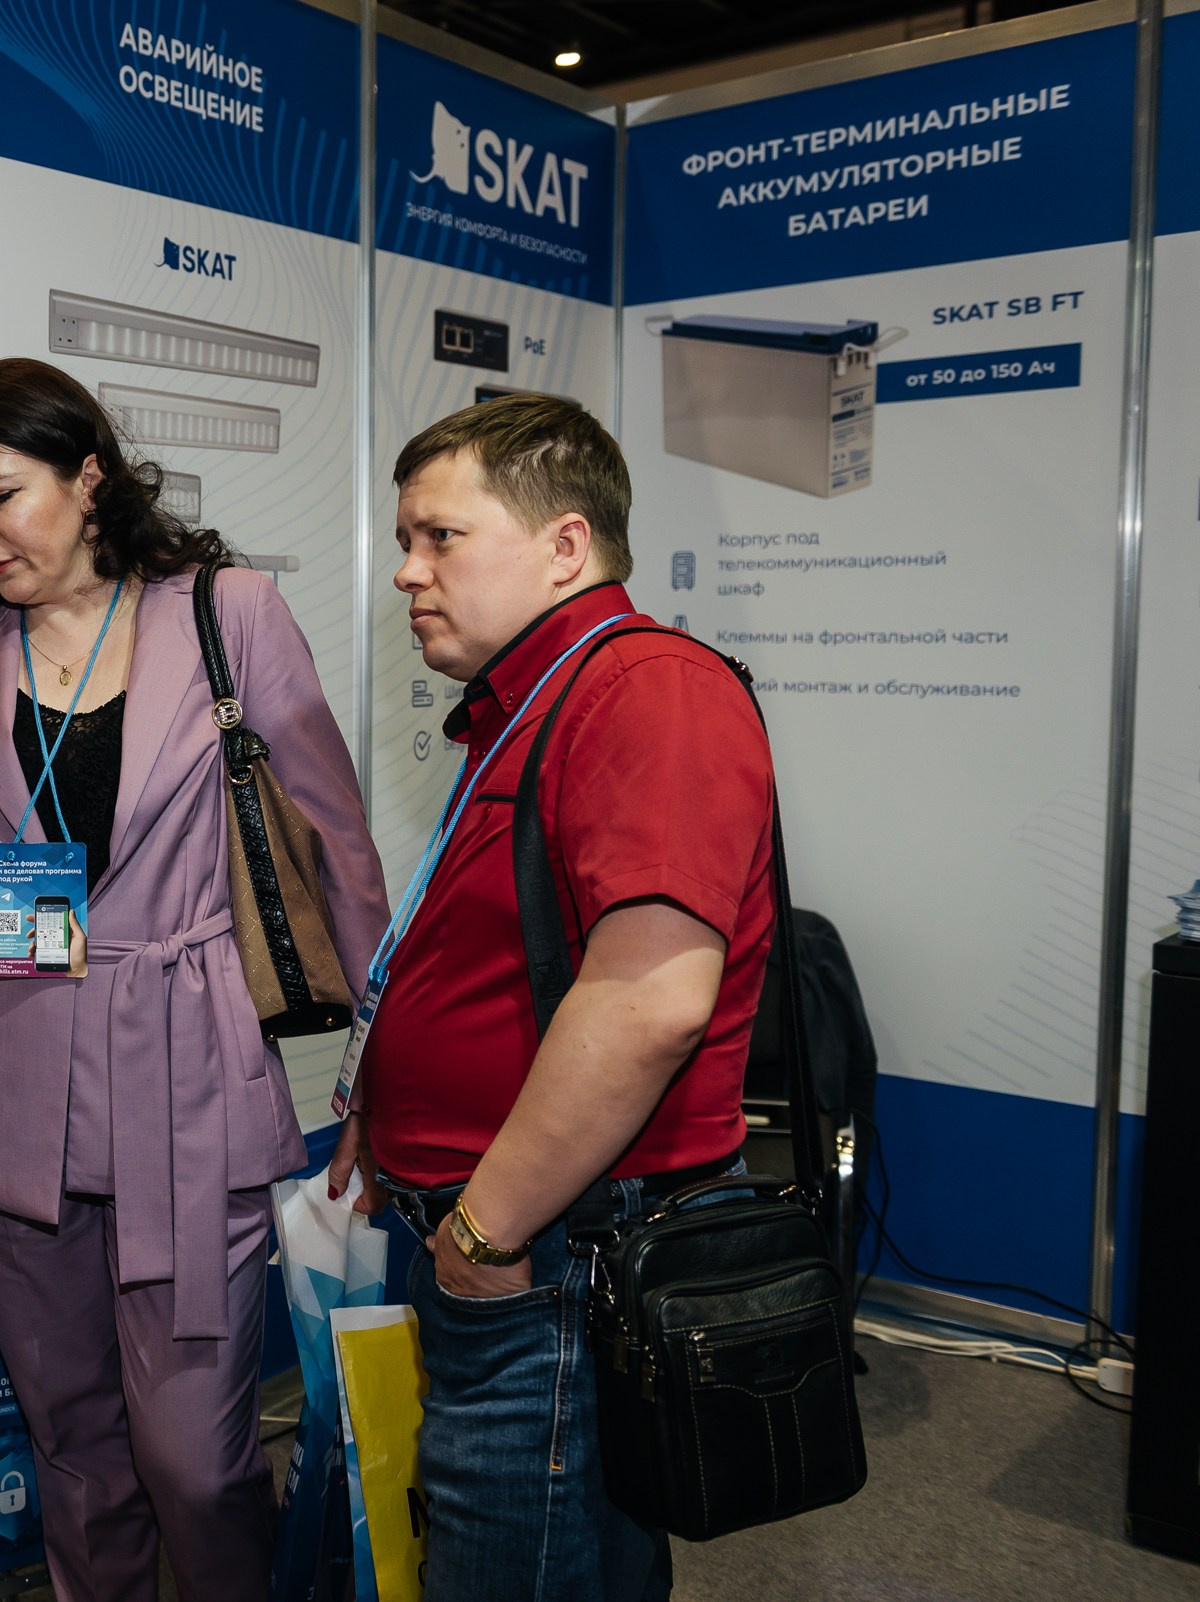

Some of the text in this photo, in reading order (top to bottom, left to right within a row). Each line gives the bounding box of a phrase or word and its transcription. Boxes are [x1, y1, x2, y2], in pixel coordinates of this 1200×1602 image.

[119, 23, 263, 94] АВАРИЙНОЕ
[118, 63, 264, 134] ОСВЕЩЕНИЕ
[681, 83, 1071, 178] ФРОНТ-ТЕРМИНАЛЬНЫЕ
[473, 128, 589, 229] SKAT
[716, 136, 1023, 210] АККУМУЛЯТОРНЫЕ
[787, 193, 930, 238] БАТАРЕИ
[405, 201, 588, 265] ЭНЕРГИЯ КОМФОРТА И БЕЗОПАСНОСТИ
[181, 245, 237, 282] SKAT
[932, 291, 1085, 326] SKAT SB FT
[524, 335, 546, 356] PoE
[905, 357, 1056, 388] от 50 до 150 Ач
[717, 530, 820, 550] Корпус под
[717, 551, 948, 573] телекоммуникационный
[717, 580, 765, 598] шкаф
[716, 627, 1010, 648] Клеммы на фронтальной части
[783, 680, 853, 695] монтаж
[858, 681, 869, 694] и
[874, 679, 1021, 699] обслуживание
[12, 875, 33, 883] рукой
[20, 860, 47, 868] форума
